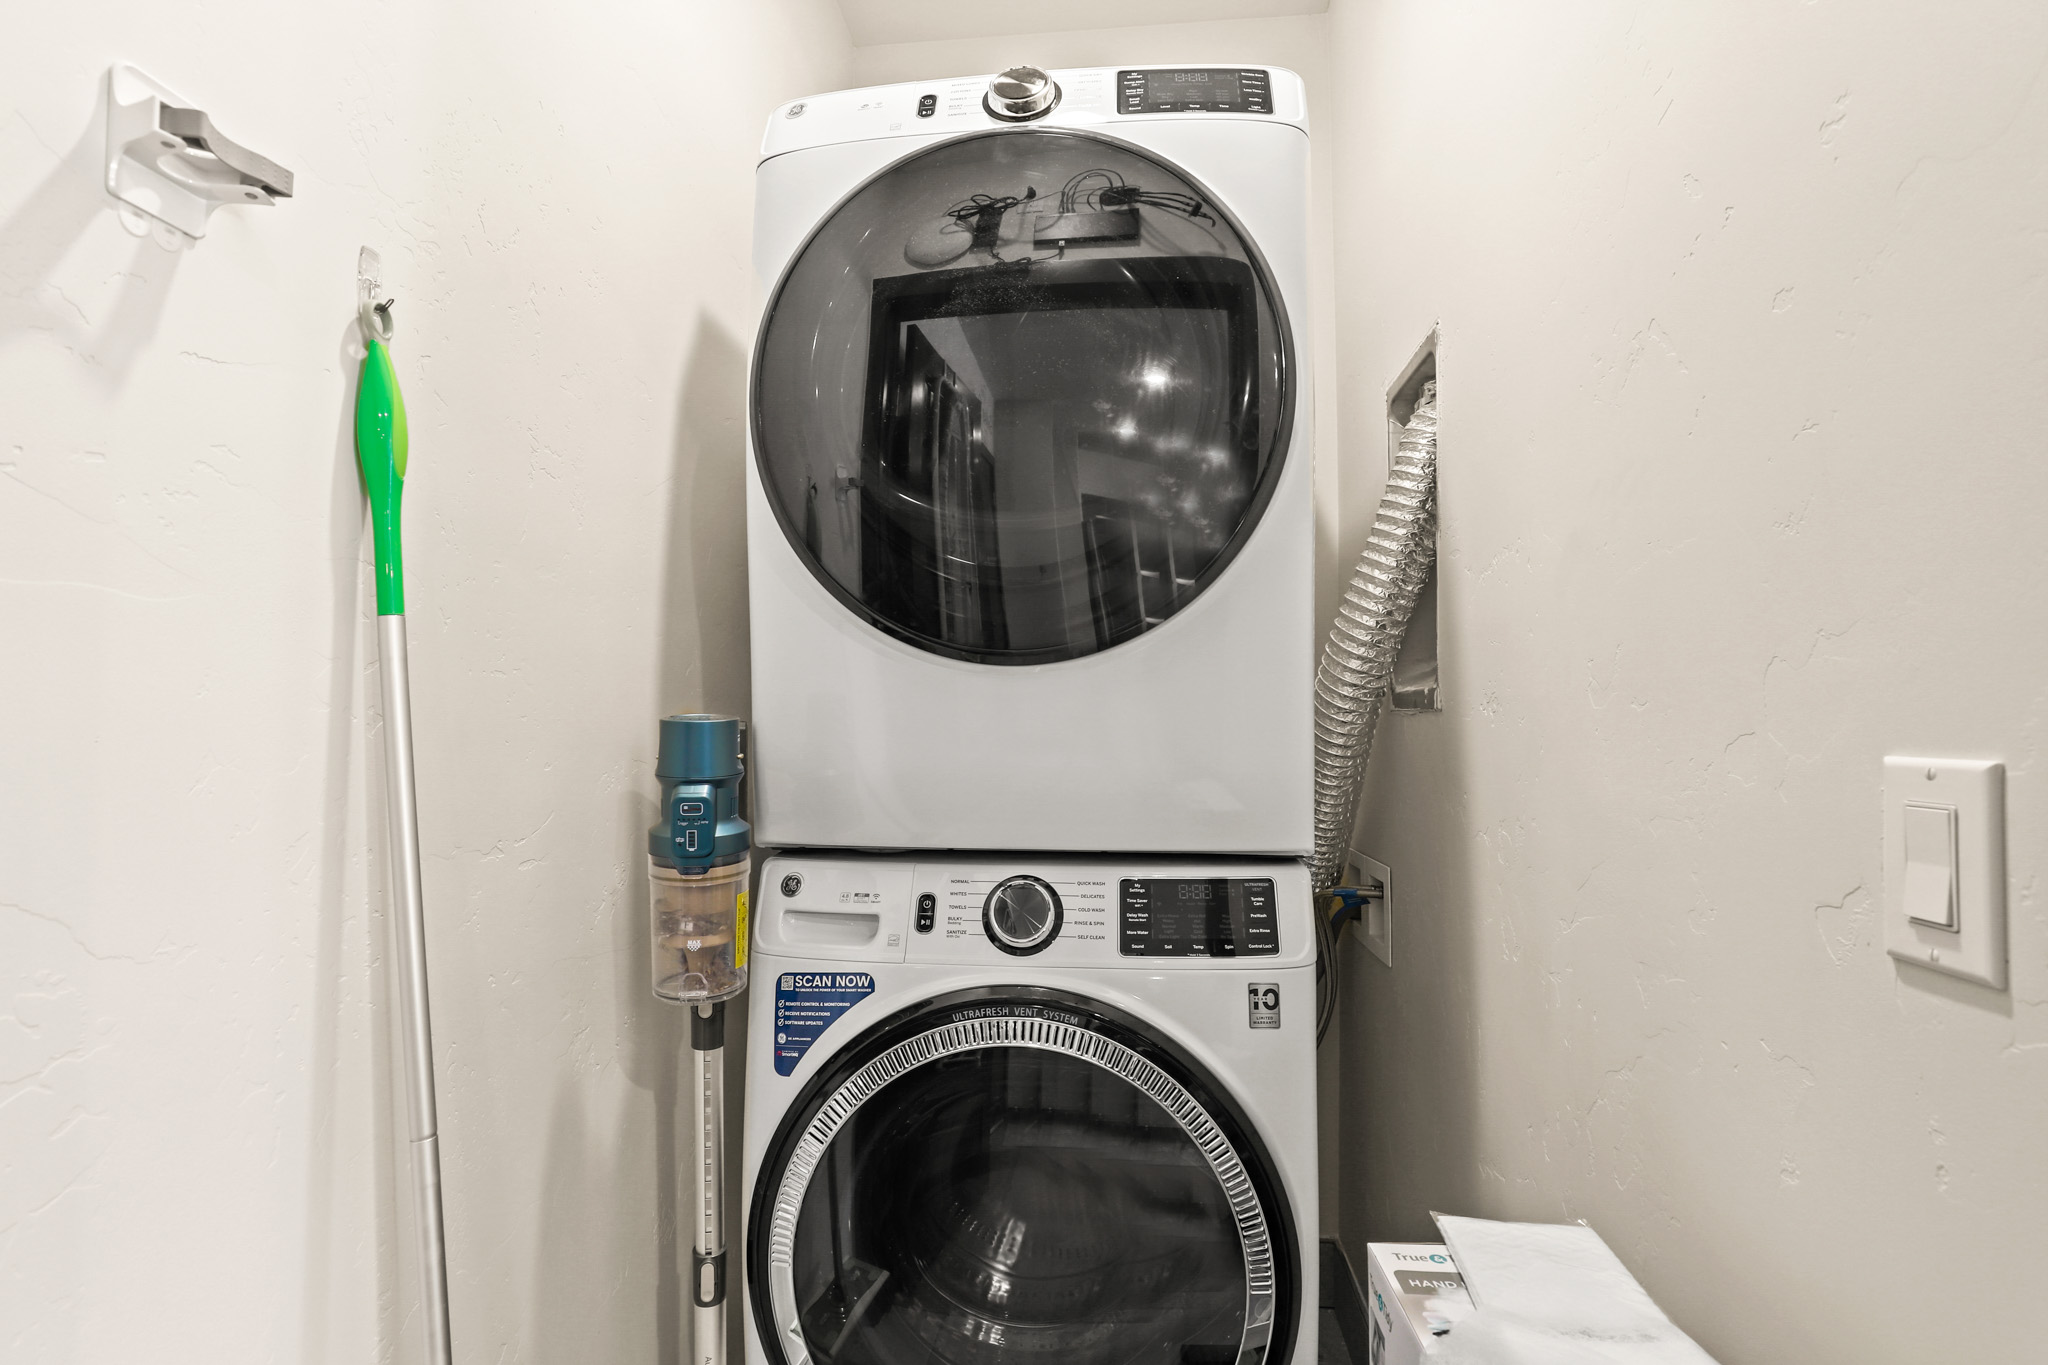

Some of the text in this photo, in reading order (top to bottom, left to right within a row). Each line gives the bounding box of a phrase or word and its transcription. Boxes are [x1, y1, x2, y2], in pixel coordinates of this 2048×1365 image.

[795, 975, 871, 987] SCAN NOW
[1249, 988, 1279, 1010] 10
[952, 1007, 1079, 1025] ULTRAFRESH VENT SYSTEM
[1408, 1279, 1457, 1289] HAND
